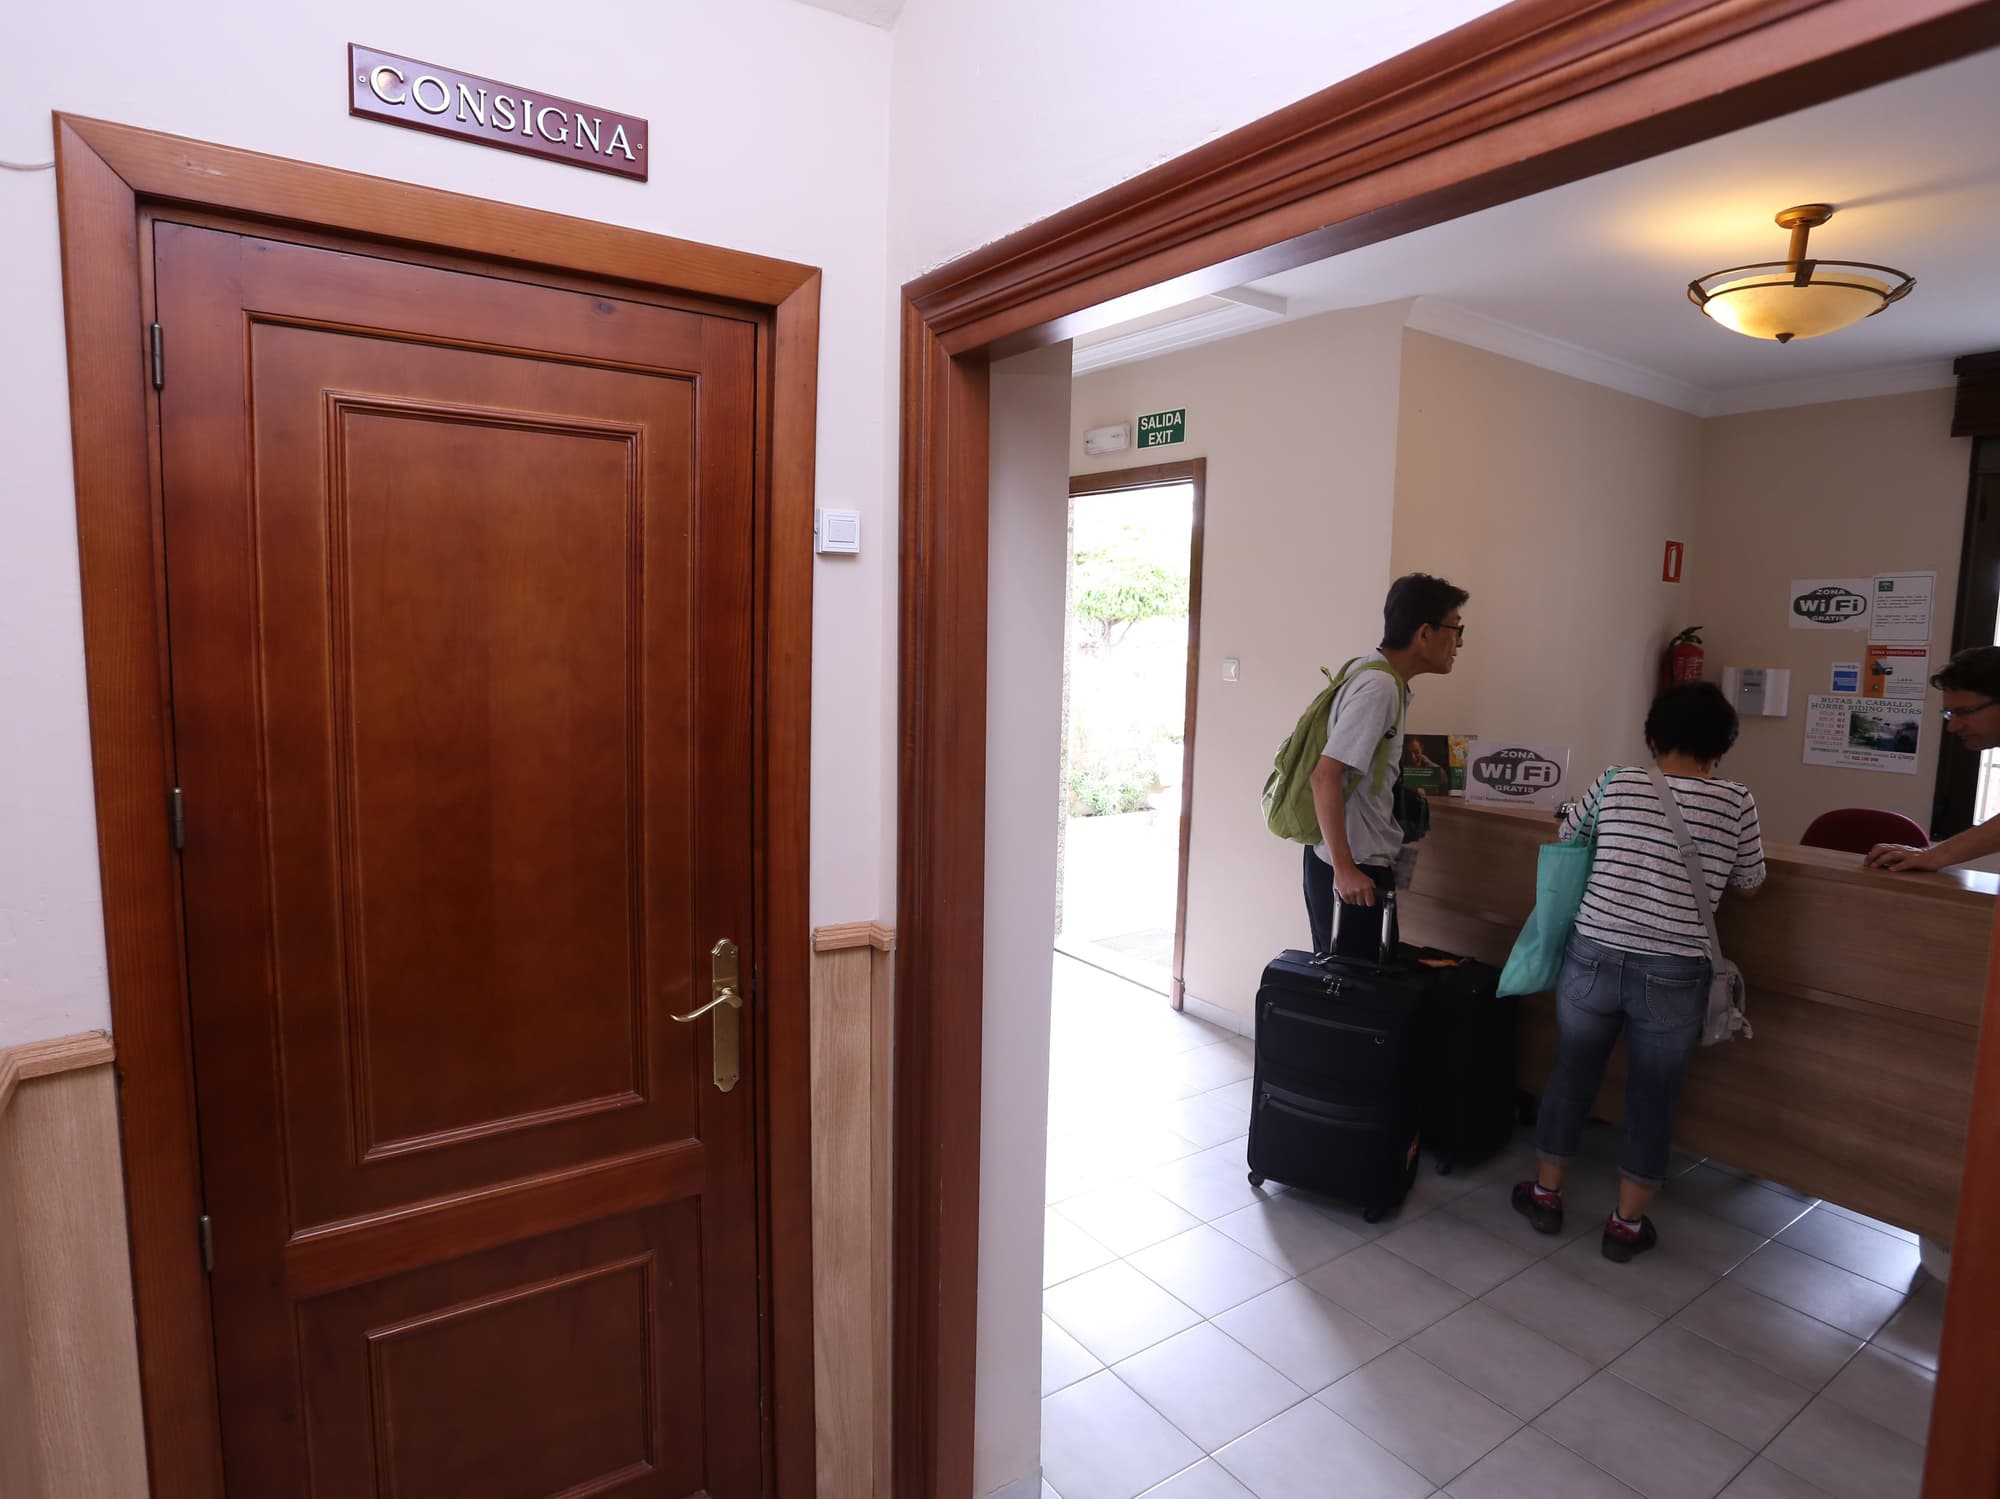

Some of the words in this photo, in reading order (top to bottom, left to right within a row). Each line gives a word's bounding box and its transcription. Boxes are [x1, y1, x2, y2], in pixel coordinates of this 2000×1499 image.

[369, 65, 637, 161] CONSIGNA
[1140, 411, 1182, 430] SALIDA
[1148, 430, 1173, 446] EXIT
[1815, 588, 1846, 596] ZONA
[1811, 615, 1845, 623] GRATIS
[1865, 699, 1913, 708] CABALLO
[1848, 704, 1884, 713] RIDING
[1887, 707, 1922, 715] TOURS
[1500, 750, 1536, 760] ZONA
[1480, 762, 1551, 783] WiFi
[1495, 784, 1535, 794] GRATIS
